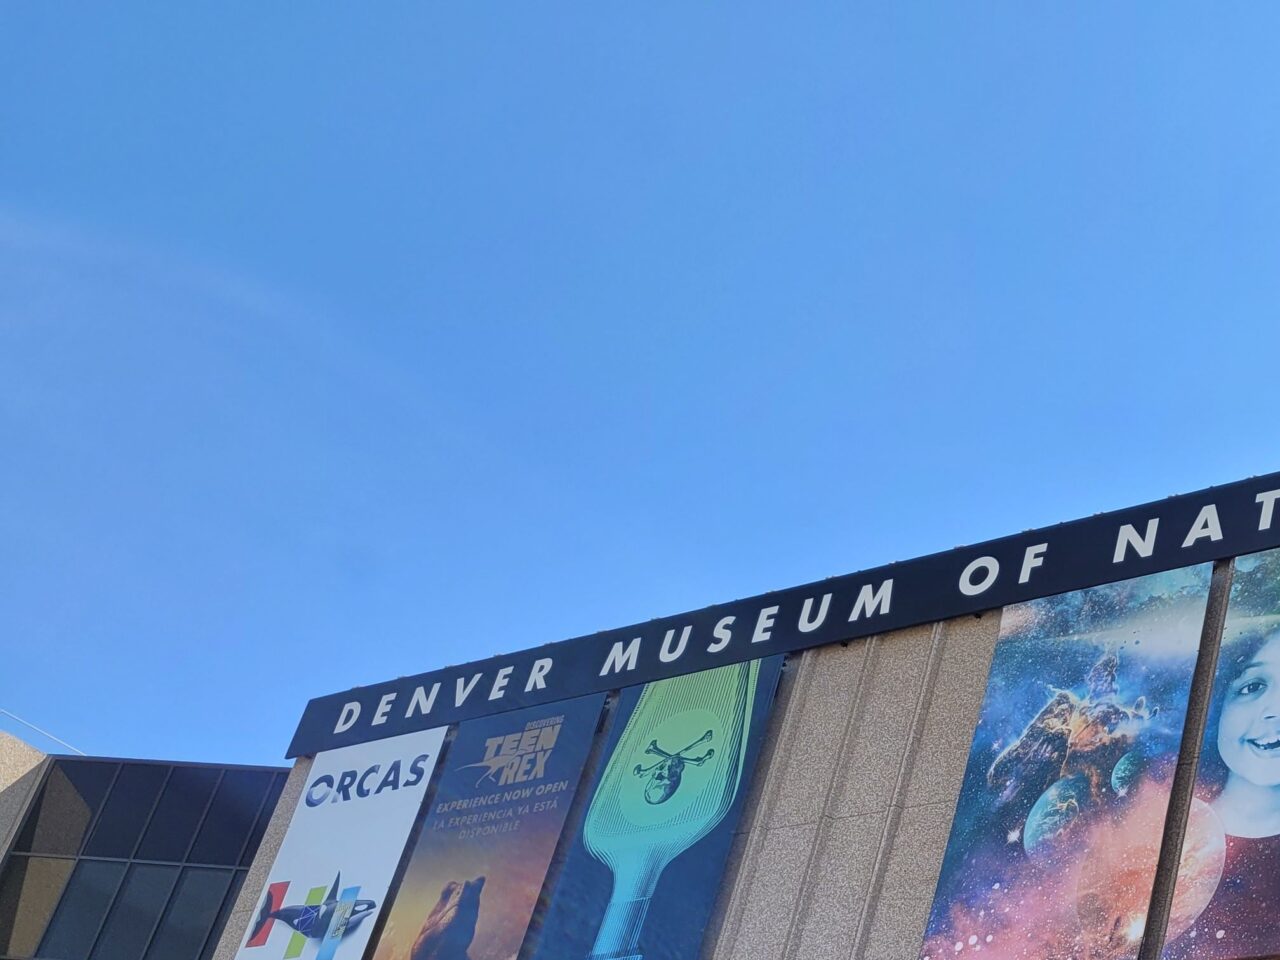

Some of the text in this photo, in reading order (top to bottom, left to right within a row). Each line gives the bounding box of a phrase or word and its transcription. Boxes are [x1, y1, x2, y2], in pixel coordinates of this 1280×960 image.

[333, 657, 554, 735] DENVER
[599, 578, 894, 677] MUSEUM
[958, 543, 1048, 596] OF
[483, 724, 562, 765] TEEN
[305, 754, 430, 808] ORCAS
[498, 749, 553, 786] REX
[436, 780, 569, 814] EXPERIENCE NOW OPEN
[448, 809, 514, 827] EXPERIENCIA
[517, 805, 530, 816] YA
[458, 820, 521, 840] DISPONIBLE
